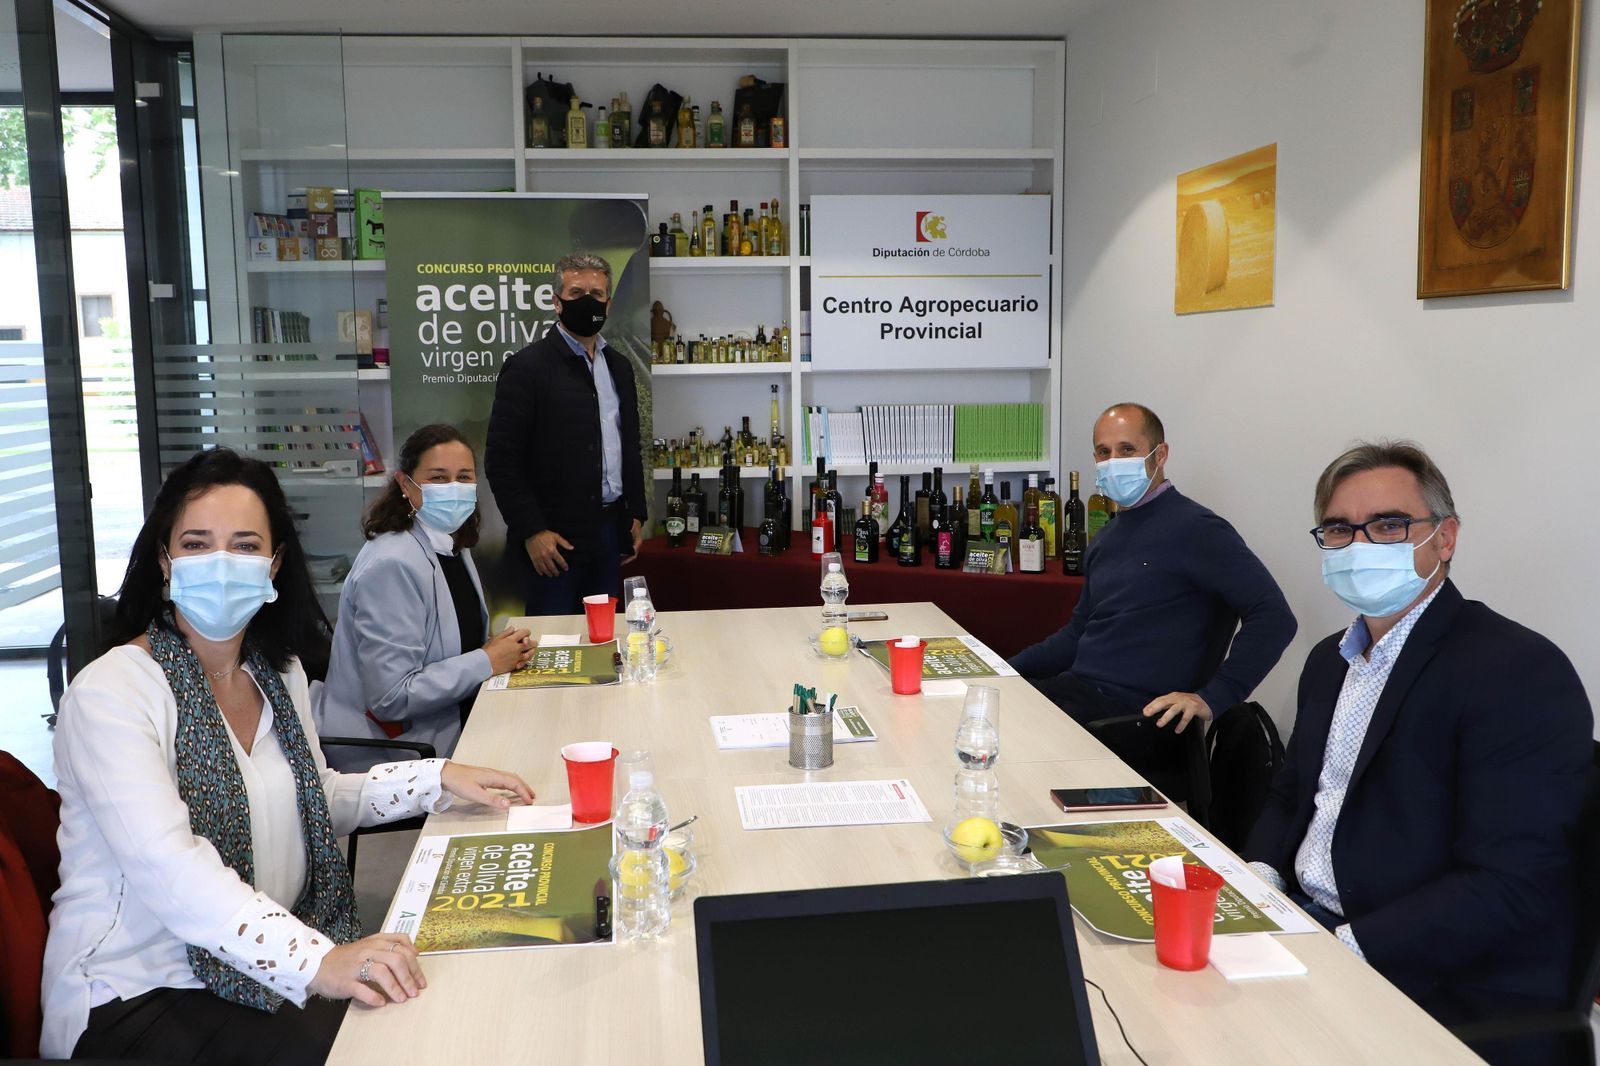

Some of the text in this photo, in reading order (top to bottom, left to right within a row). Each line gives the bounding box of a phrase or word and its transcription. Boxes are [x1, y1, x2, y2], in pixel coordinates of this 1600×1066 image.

[872, 247, 990, 259] Diputación de Córdoba
[416, 263, 484, 274] CONCURSO
[415, 275, 558, 312] aceite
[822, 295, 1039, 318] Centro Agropecuario
[418, 312, 462, 345] de
[880, 322, 982, 340] Provincial
[420, 346, 494, 372] virgen
[422, 374, 454, 384] Premio
[452, 846, 482, 894] virgen extra
[472, 844, 510, 893] de oliva
[503, 843, 539, 892] aceite
[535, 842, 554, 906] CONCURSO PROVINCIAL
[1086, 856, 1125, 890] PROVINCIAL
[432, 892, 532, 912] 2021
[1216, 894, 1246, 921] virge
